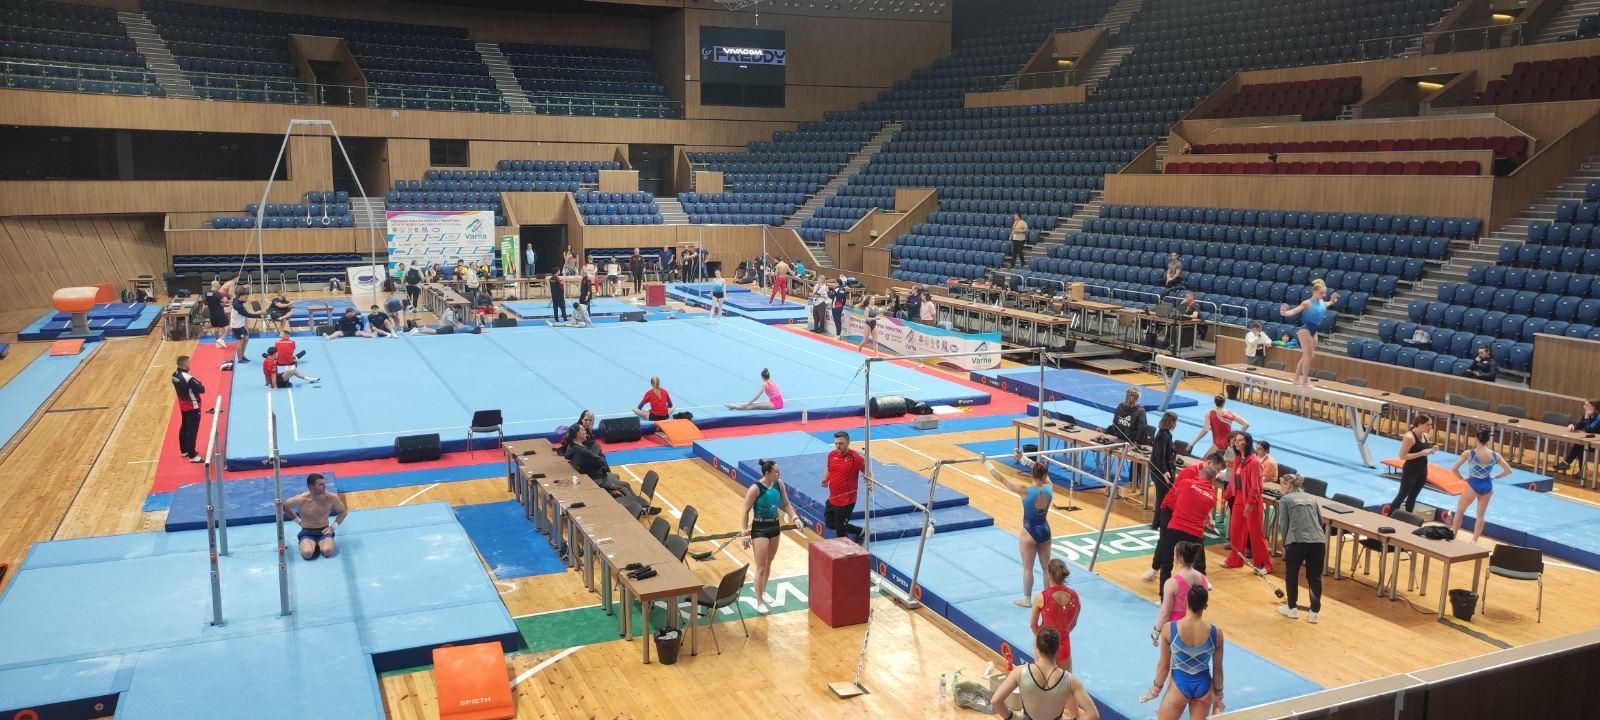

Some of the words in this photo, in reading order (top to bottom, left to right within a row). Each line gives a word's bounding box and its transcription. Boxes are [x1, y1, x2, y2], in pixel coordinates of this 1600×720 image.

[723, 47, 762, 55] VIVACOM
[971, 357, 992, 365] Varna
[459, 697, 491, 706] SPIETH
